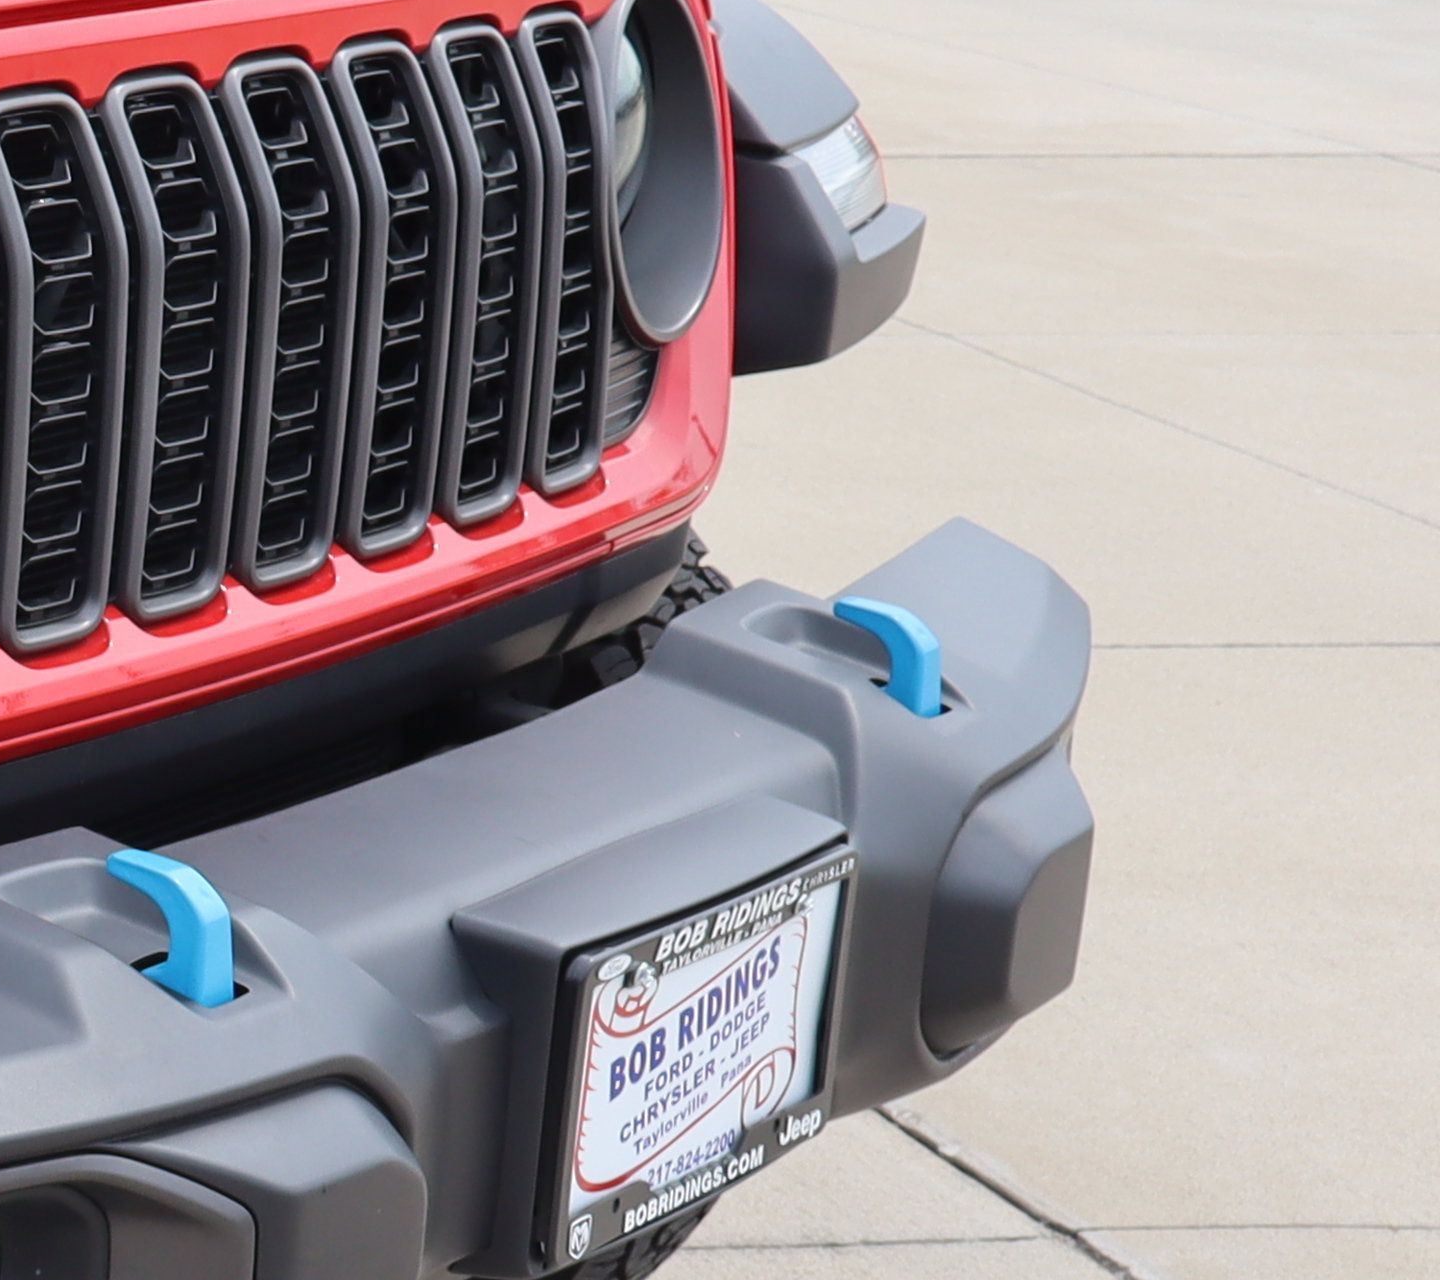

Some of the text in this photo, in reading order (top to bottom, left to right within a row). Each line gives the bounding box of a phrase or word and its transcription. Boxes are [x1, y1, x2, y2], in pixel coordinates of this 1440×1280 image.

[655, 857, 856, 962] BOB RIDINGS CHRYSLER
[662, 929, 741, 975] TAYLORVILLE
[751, 912, 784, 937] PANA
[609, 935, 781, 1102] BOB RIDINGS
[644, 1052, 694, 1101] FORD
[710, 991, 767, 1052] DODGE
[619, 1058, 716, 1143] CHRYSLER
[730, 1012, 770, 1059] JEEP
[633, 1054, 752, 1155] Taylorville Pana
[779, 1108, 822, 1146] Jeep
[623, 1144, 765, 1234] BOBRIDINGS.COM
[647, 1129, 737, 1187] 217-824-2200
